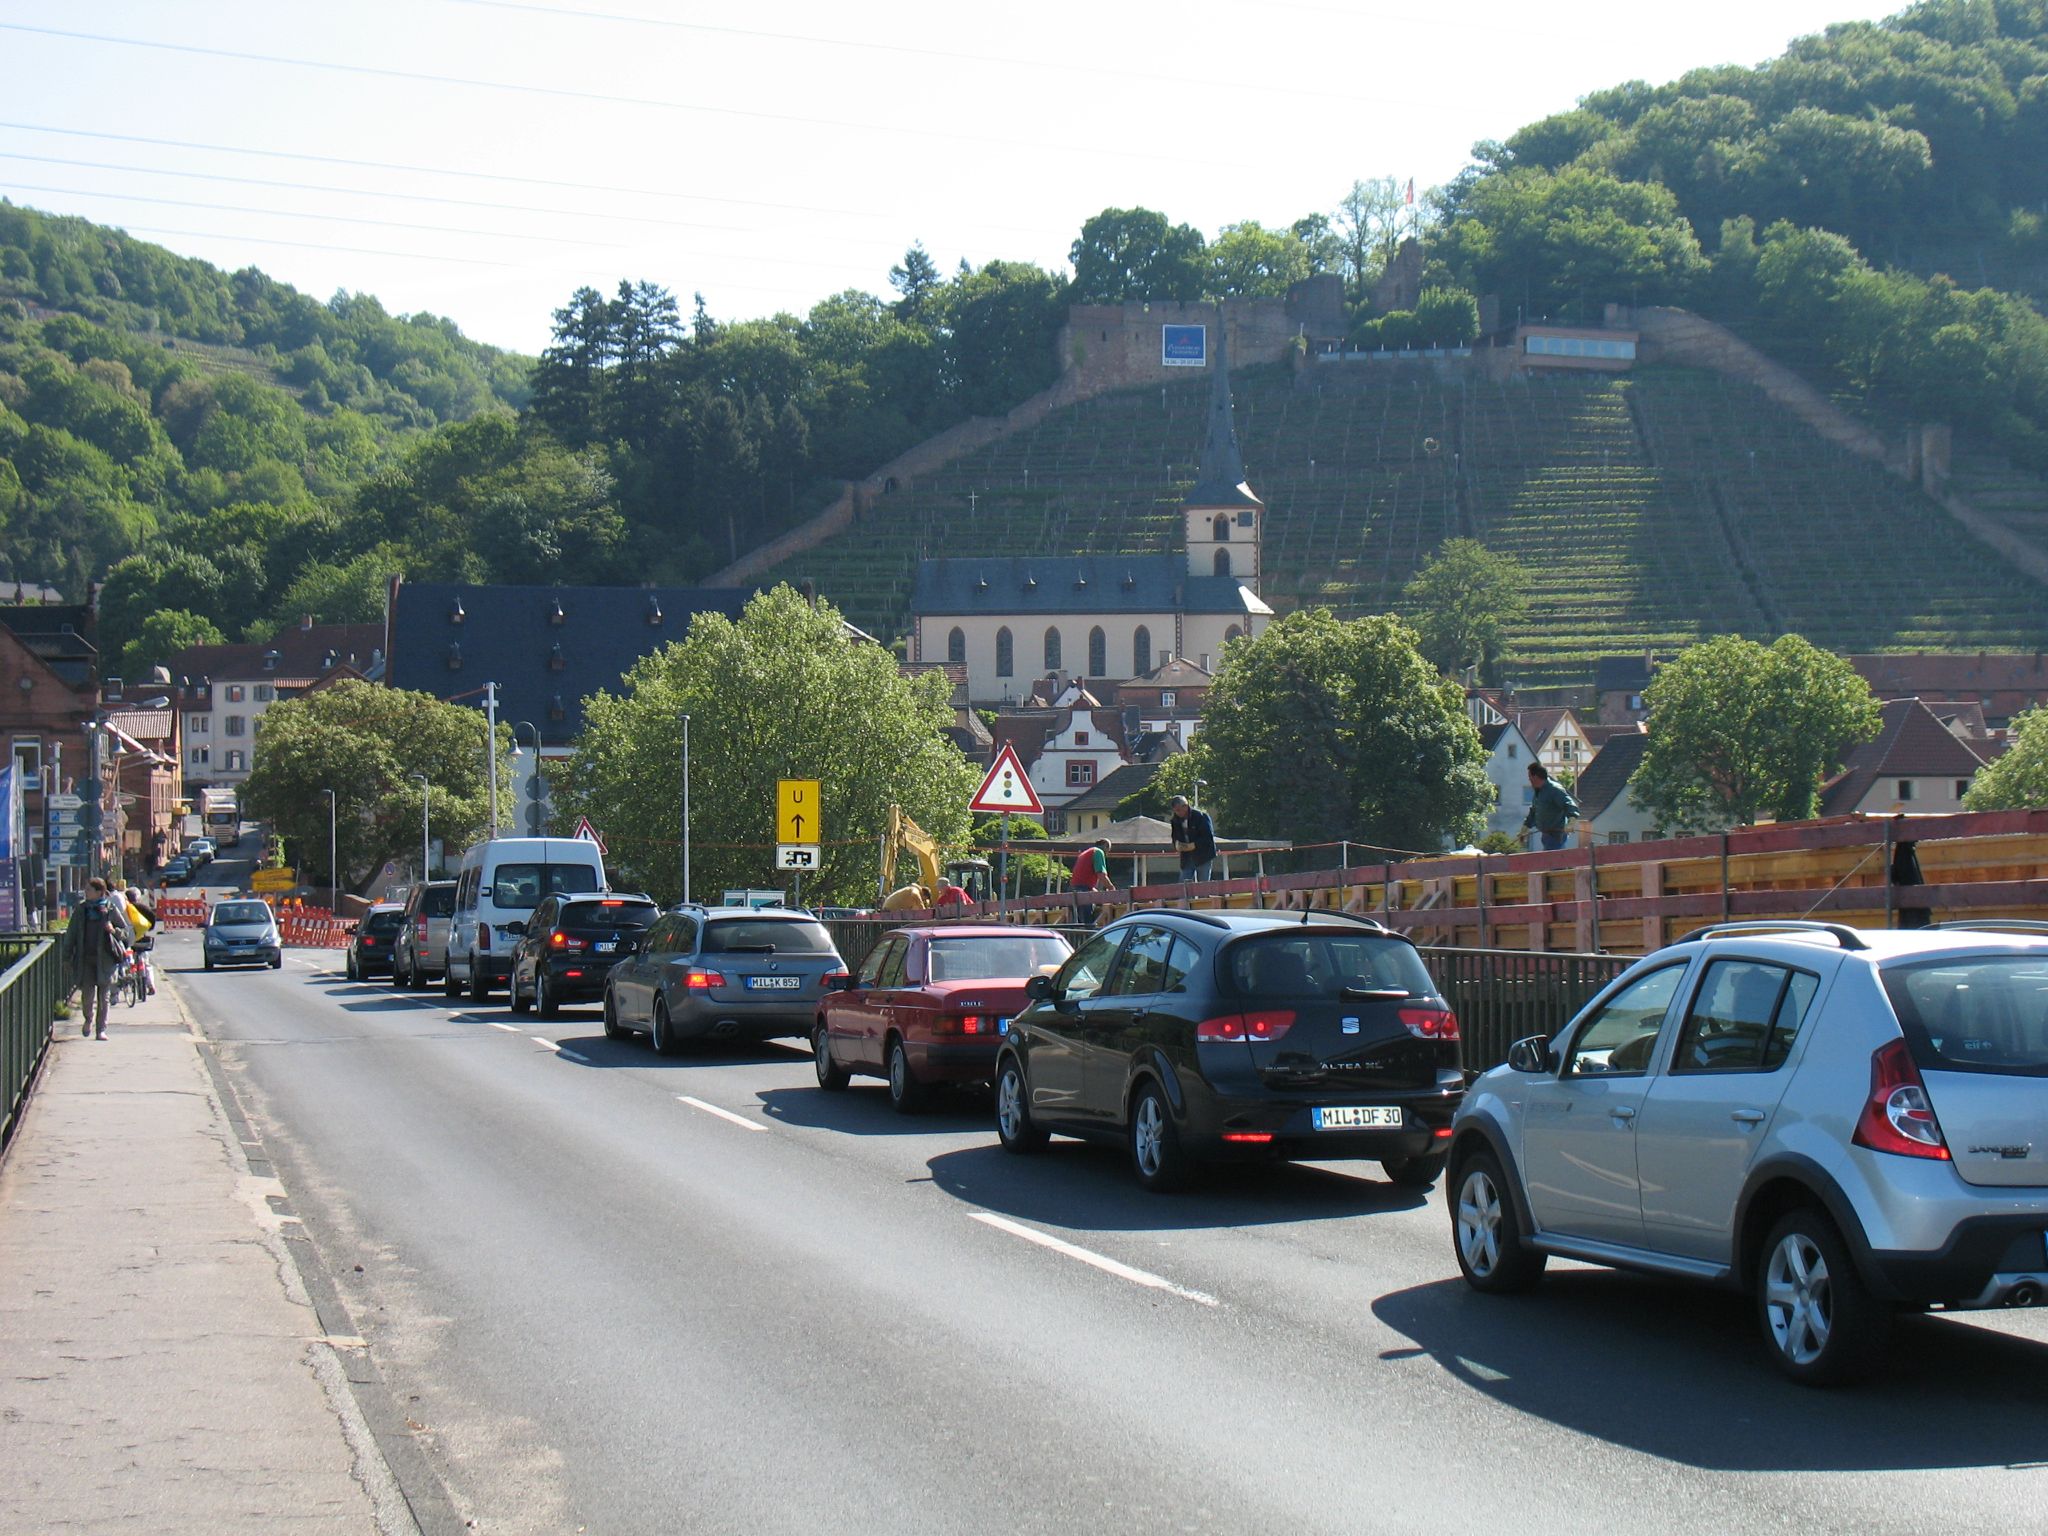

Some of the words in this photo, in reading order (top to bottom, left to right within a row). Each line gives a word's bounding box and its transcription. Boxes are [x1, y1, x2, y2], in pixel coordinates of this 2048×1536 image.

[793, 789, 803, 804] U
[752, 978, 770, 987] MIL
[775, 978, 781, 987] K
[783, 978, 799, 987] 852
[1321, 1062, 1361, 1070] ALTEA
[1323, 1109, 1352, 1125] MIL
[1362, 1109, 1380, 1124] DF
[1384, 1108, 1401, 1124] 30
